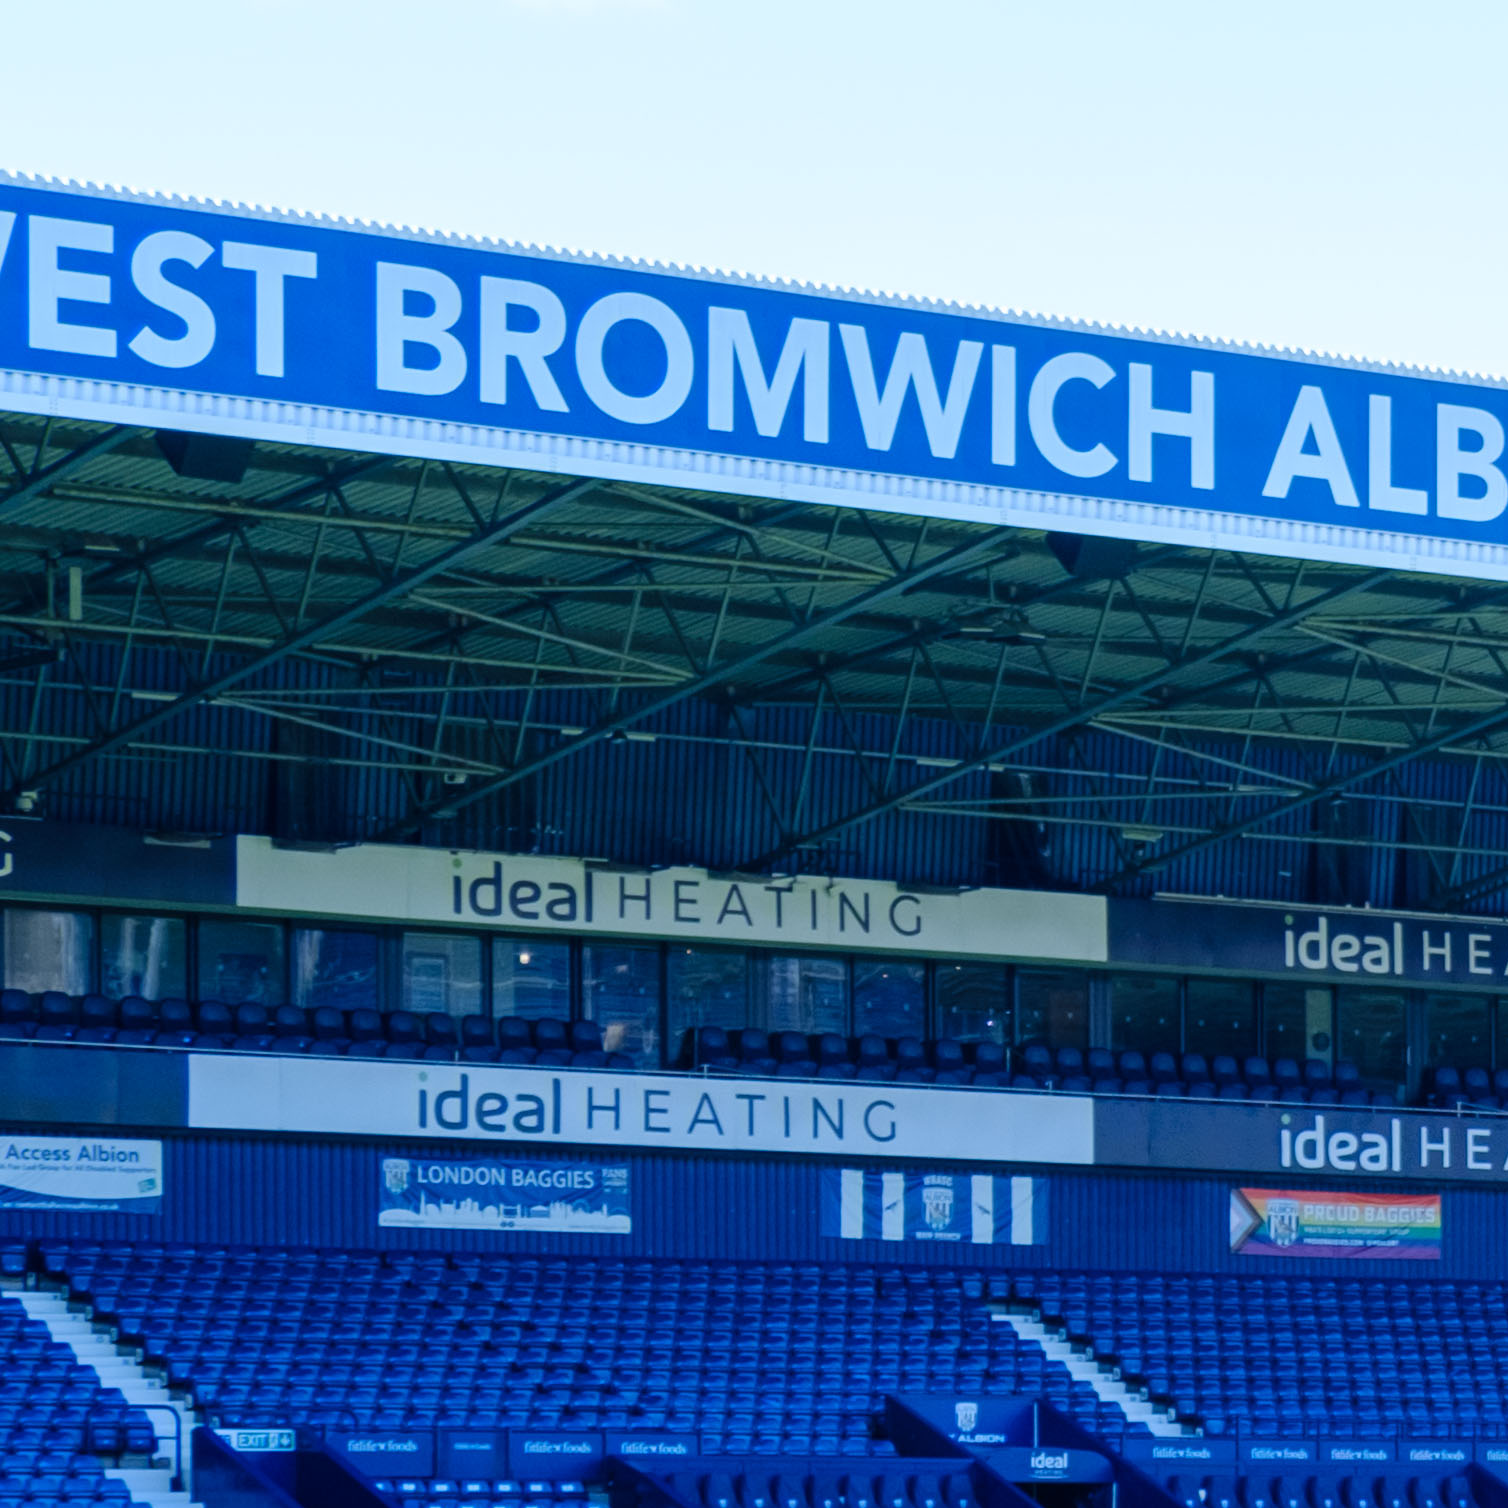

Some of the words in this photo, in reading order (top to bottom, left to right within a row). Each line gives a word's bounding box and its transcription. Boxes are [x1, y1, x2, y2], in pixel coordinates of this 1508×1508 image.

[0, 211, 318, 378] EST
[377, 262, 1214, 490] BROMWICH
[452, 858, 593, 922] ideal
[618, 874, 922, 937] HEATING
[1285, 914, 1403, 974] ideal
[418, 1072, 561, 1135] ideal
[586, 1086, 897, 1143] HEATING
[5, 1143, 71, 1161] Access
[77, 1144, 140, 1162] Albion
[1280, 1113, 1400, 1172] ideal
[417, 1165, 505, 1186] LONDON
[511, 1168, 594, 1188] BAGGIES
[1303, 1204, 1359, 1222] PROUD
[1364, 1206, 1436, 1224] BAGGIES
[238, 1433, 267, 1449] EXIT
[563, 1441, 593, 1454] foods
[958, 1433, 1006, 1443] ALBION
[658, 1442, 688, 1455] foods
[1031, 1451, 1068, 1468] ideal
